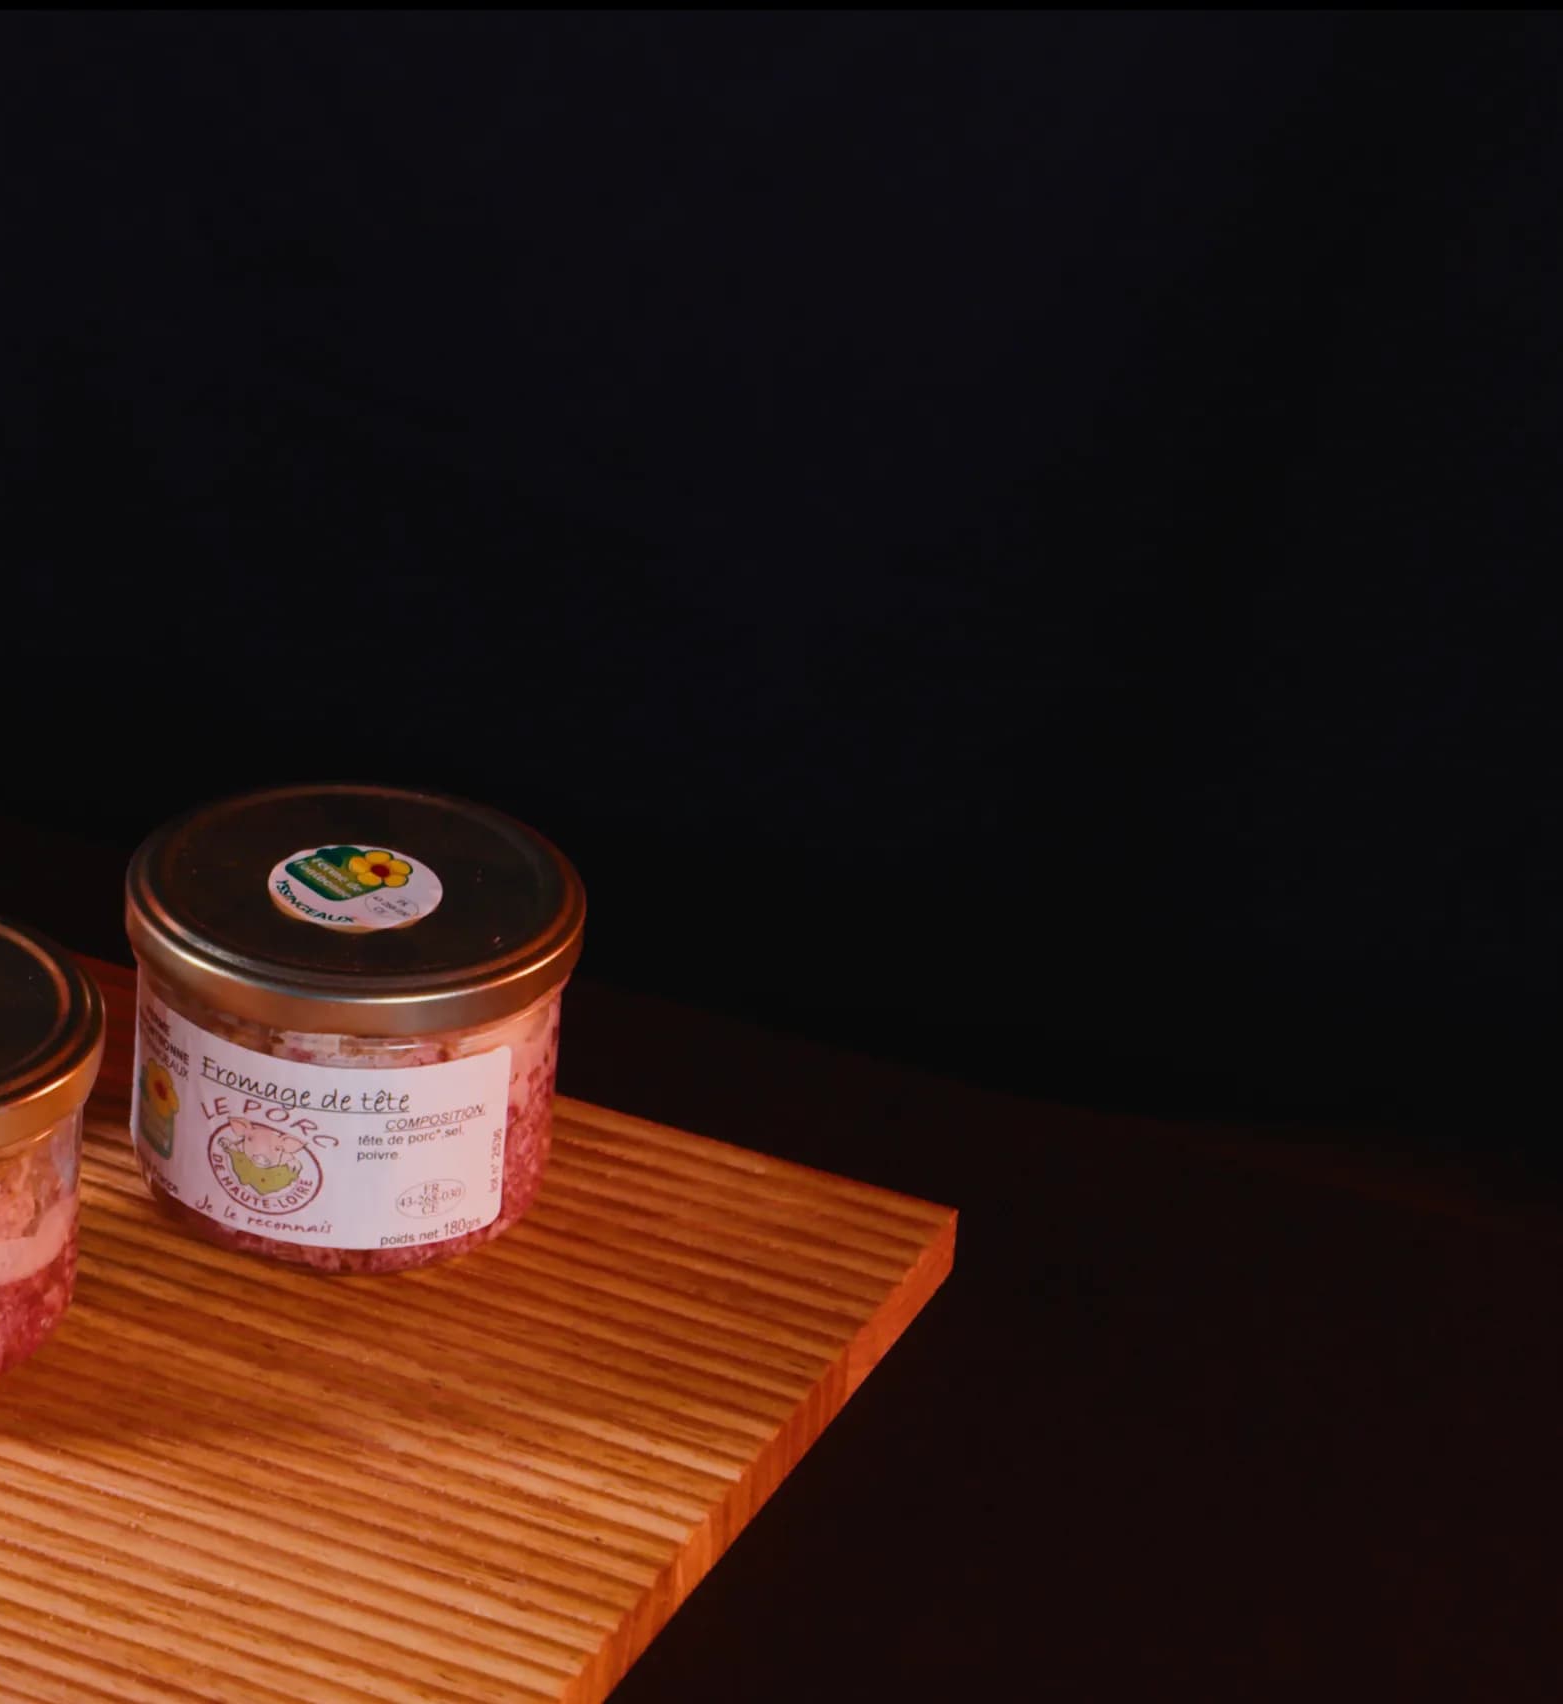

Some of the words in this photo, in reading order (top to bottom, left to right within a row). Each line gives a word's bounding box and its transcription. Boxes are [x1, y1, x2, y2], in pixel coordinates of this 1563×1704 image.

[201, 1055, 311, 1110] Fromage
[321, 1089, 351, 1112] de
[361, 1089, 410, 1113] tête
[201, 1097, 230, 1119] LE
[243, 1099, 339, 1148] PORC
[358, 1134, 384, 1147] tête
[387, 1130, 404, 1145] de
[384, 1104, 485, 1133] COMPOSITION
[212, 1153, 224, 1172] DE
[222, 1177, 313, 1209] HAUTE-LOIRE
[195, 1194, 213, 1213] Je
[223, 1205, 237, 1220] le
[247, 1216, 333, 1234] reconnais
[380, 1233, 417, 1248] poids
[419, 1229, 440, 1241] net
